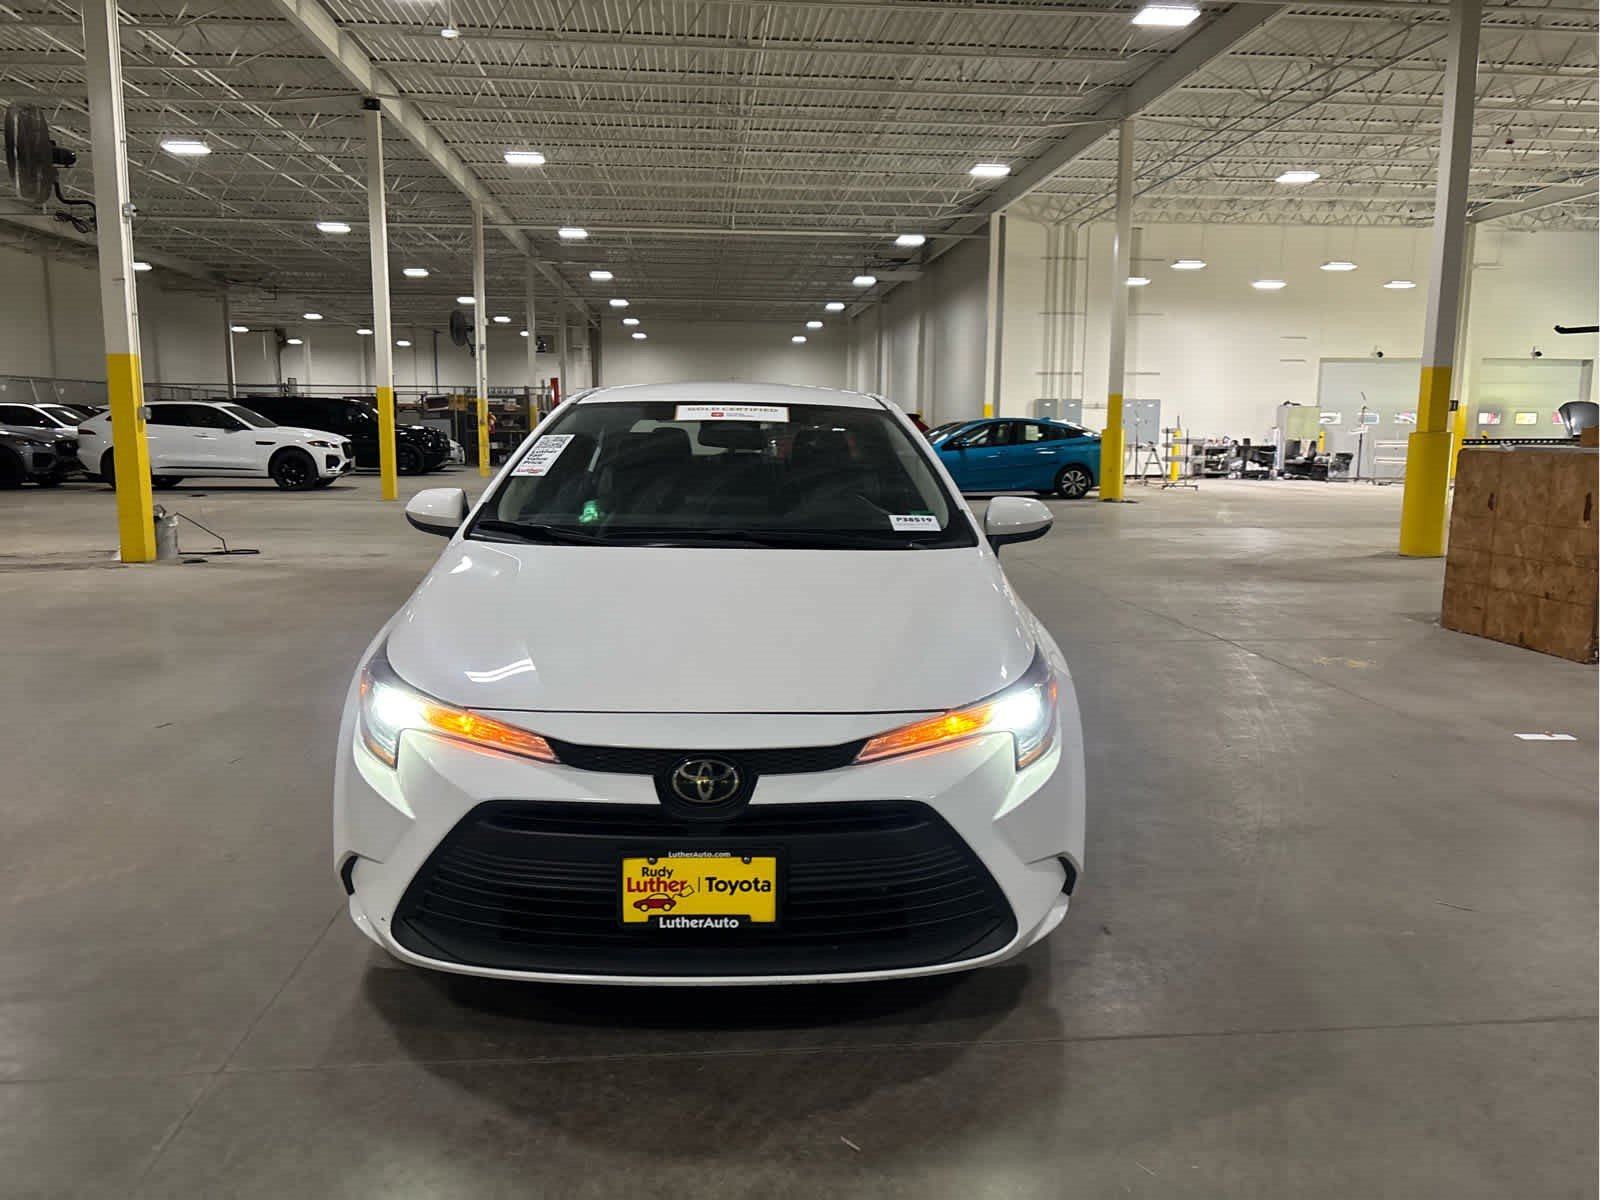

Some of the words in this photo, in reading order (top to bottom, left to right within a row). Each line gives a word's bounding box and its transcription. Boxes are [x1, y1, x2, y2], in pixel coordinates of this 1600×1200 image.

[642, 867, 673, 878] Rudy
[626, 877, 687, 893] Luther
[705, 877, 771, 895] Toyota
[659, 917, 739, 928] LutherAuto
